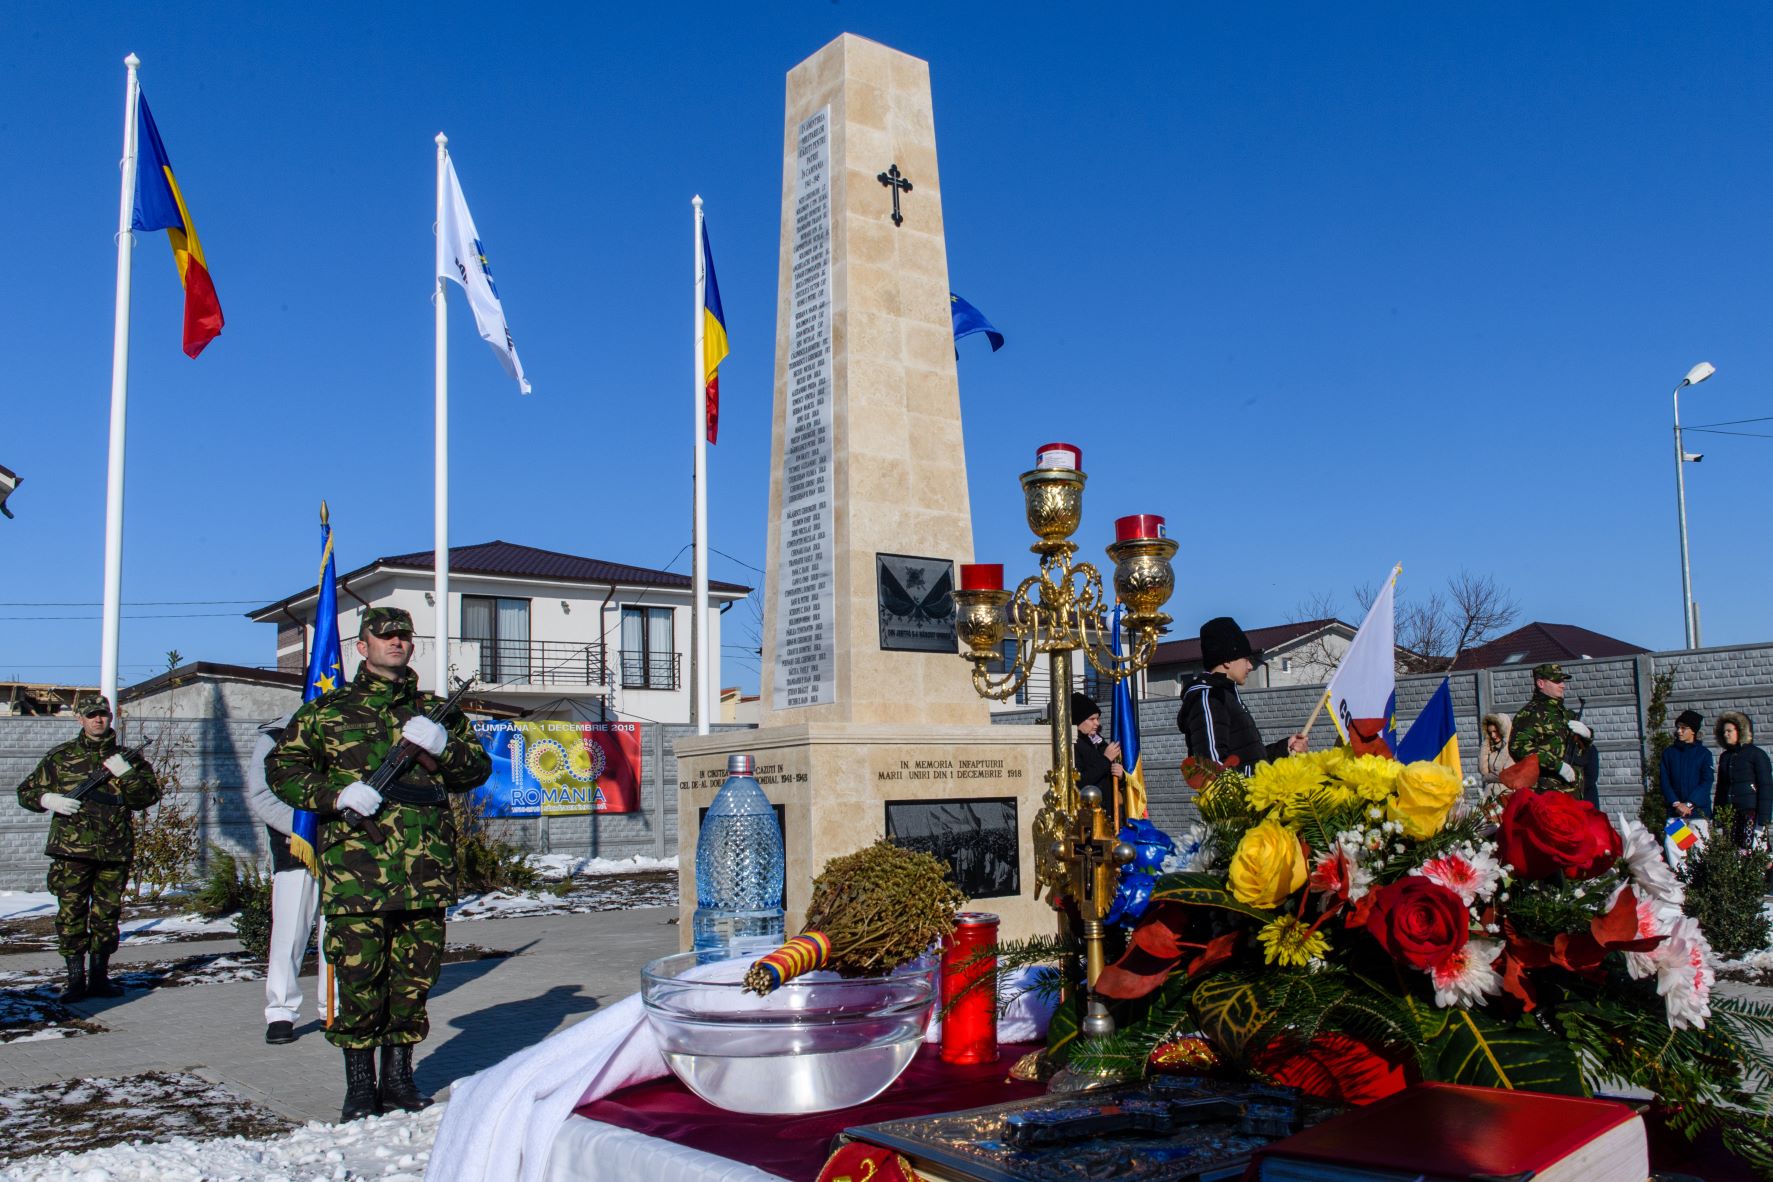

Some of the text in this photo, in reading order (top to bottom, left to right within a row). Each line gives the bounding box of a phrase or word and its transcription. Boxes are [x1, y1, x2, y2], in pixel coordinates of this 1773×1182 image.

[548, 724, 608, 732] DECEMBRIE
[508, 734, 606, 789] 100
[900, 760, 1004, 769] IN MEMORIA INFAPTUIRII
[878, 771, 902, 780] MARII
[909, 771, 930, 780] UNIRI
[934, 770, 947, 779] DIN
[957, 770, 1002, 778] DECEMBRIE
[1008, 769, 1022, 778] 1918
[680, 782, 690, 790] CEL
[511, 784, 606, 805] ROMÂNIA
